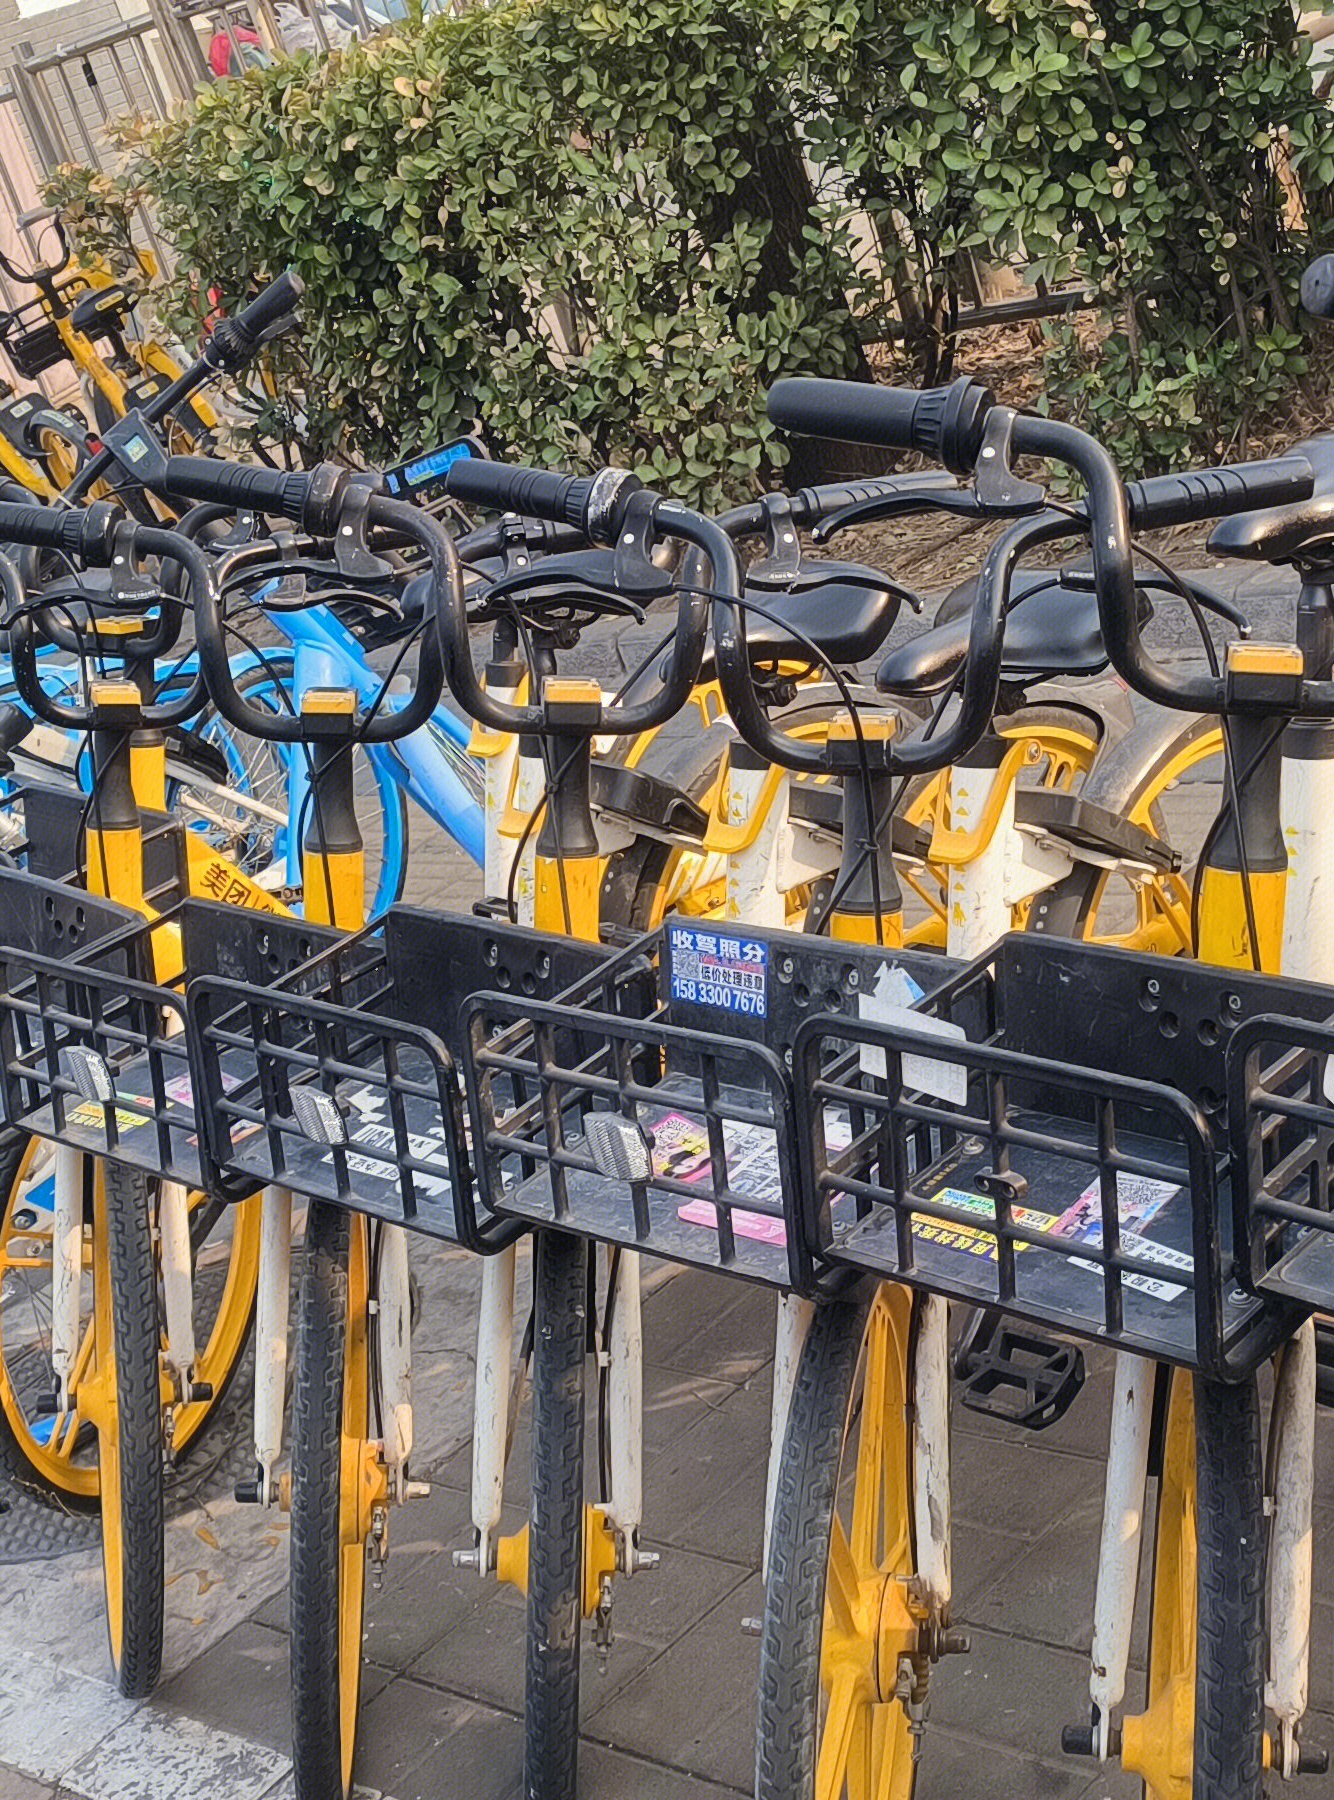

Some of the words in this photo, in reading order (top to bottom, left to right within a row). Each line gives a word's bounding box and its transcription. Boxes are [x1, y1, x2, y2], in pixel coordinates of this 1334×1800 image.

[199, 862, 252, 908] 美团
[672, 929, 764, 963] 收驾照分
[672, 977, 696, 1001] 158
[698, 982, 731, 1008] 3300
[732, 990, 765, 1015] 7676
